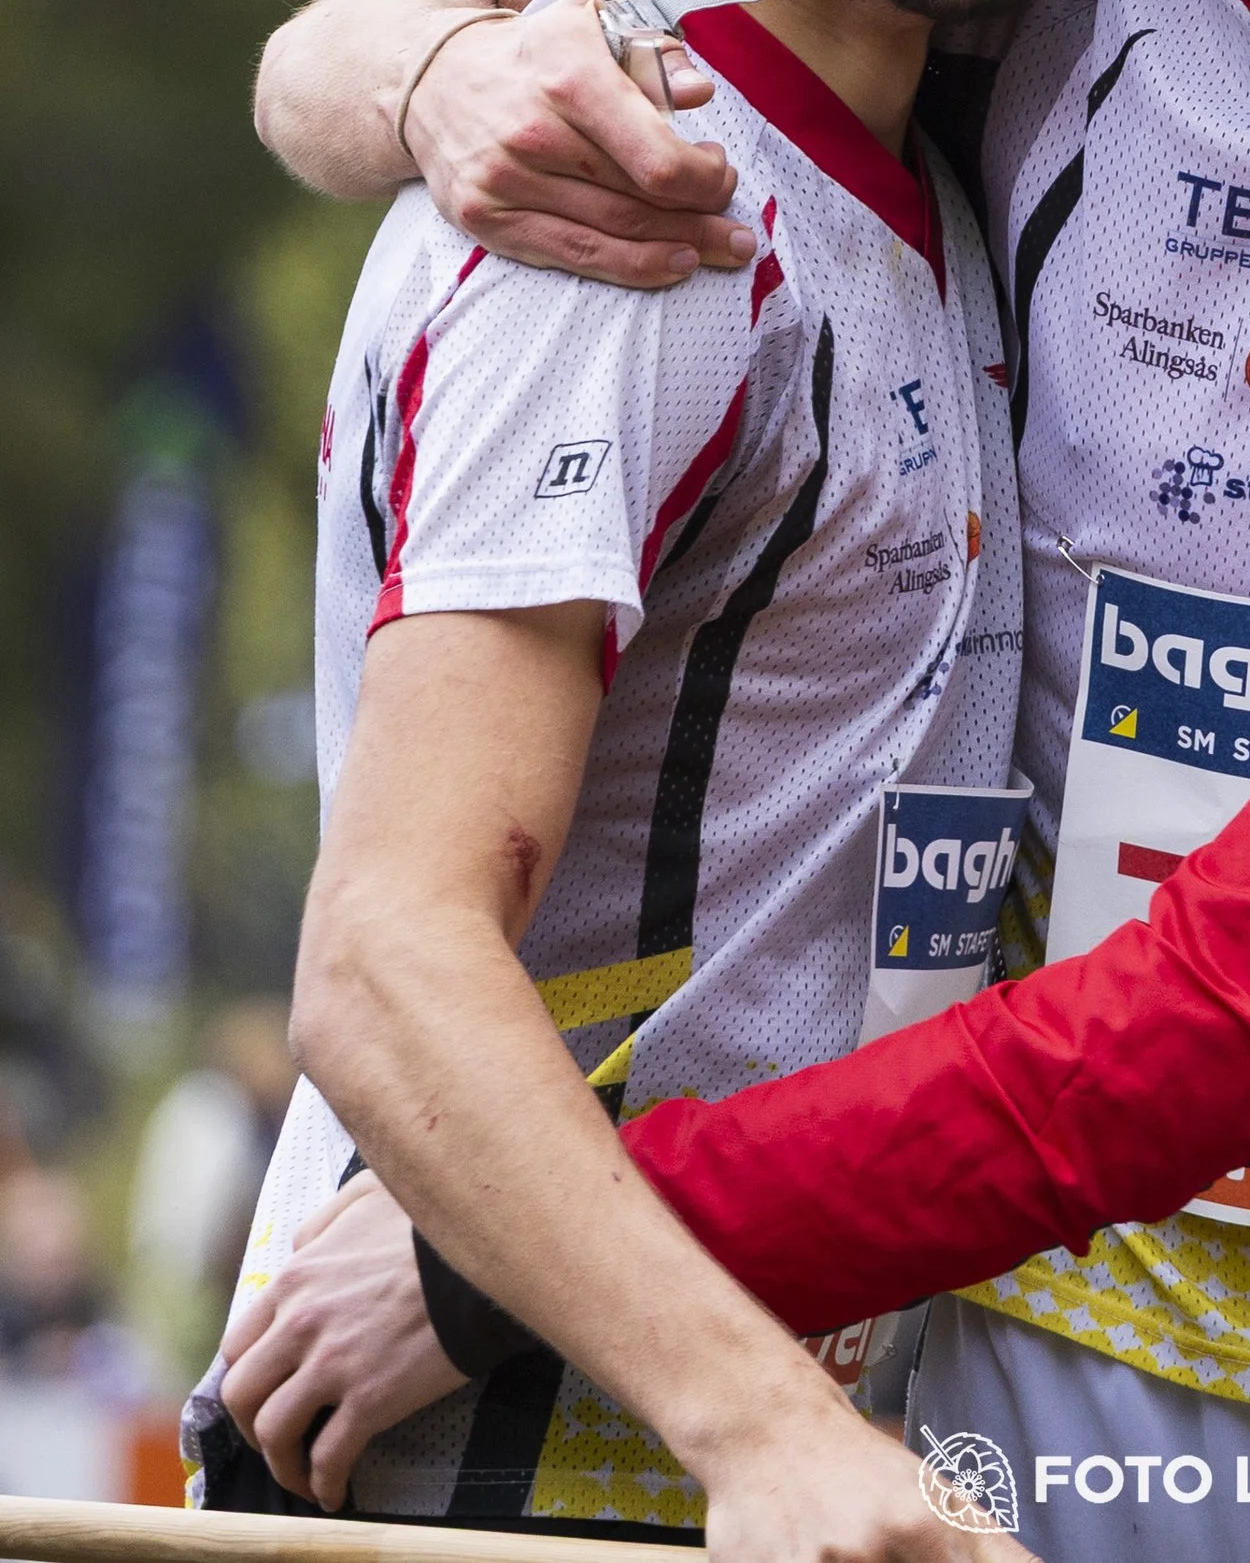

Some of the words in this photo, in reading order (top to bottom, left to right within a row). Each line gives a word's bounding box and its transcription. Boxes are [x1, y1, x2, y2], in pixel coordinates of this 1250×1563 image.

[1092, 291, 1225, 351] Sparbanken
[1118, 335, 1219, 382] Alingsås
[1177, 725, 1216, 755] SM
[883, 822, 1021, 904] bagh
[928, 933, 953, 957] SM
